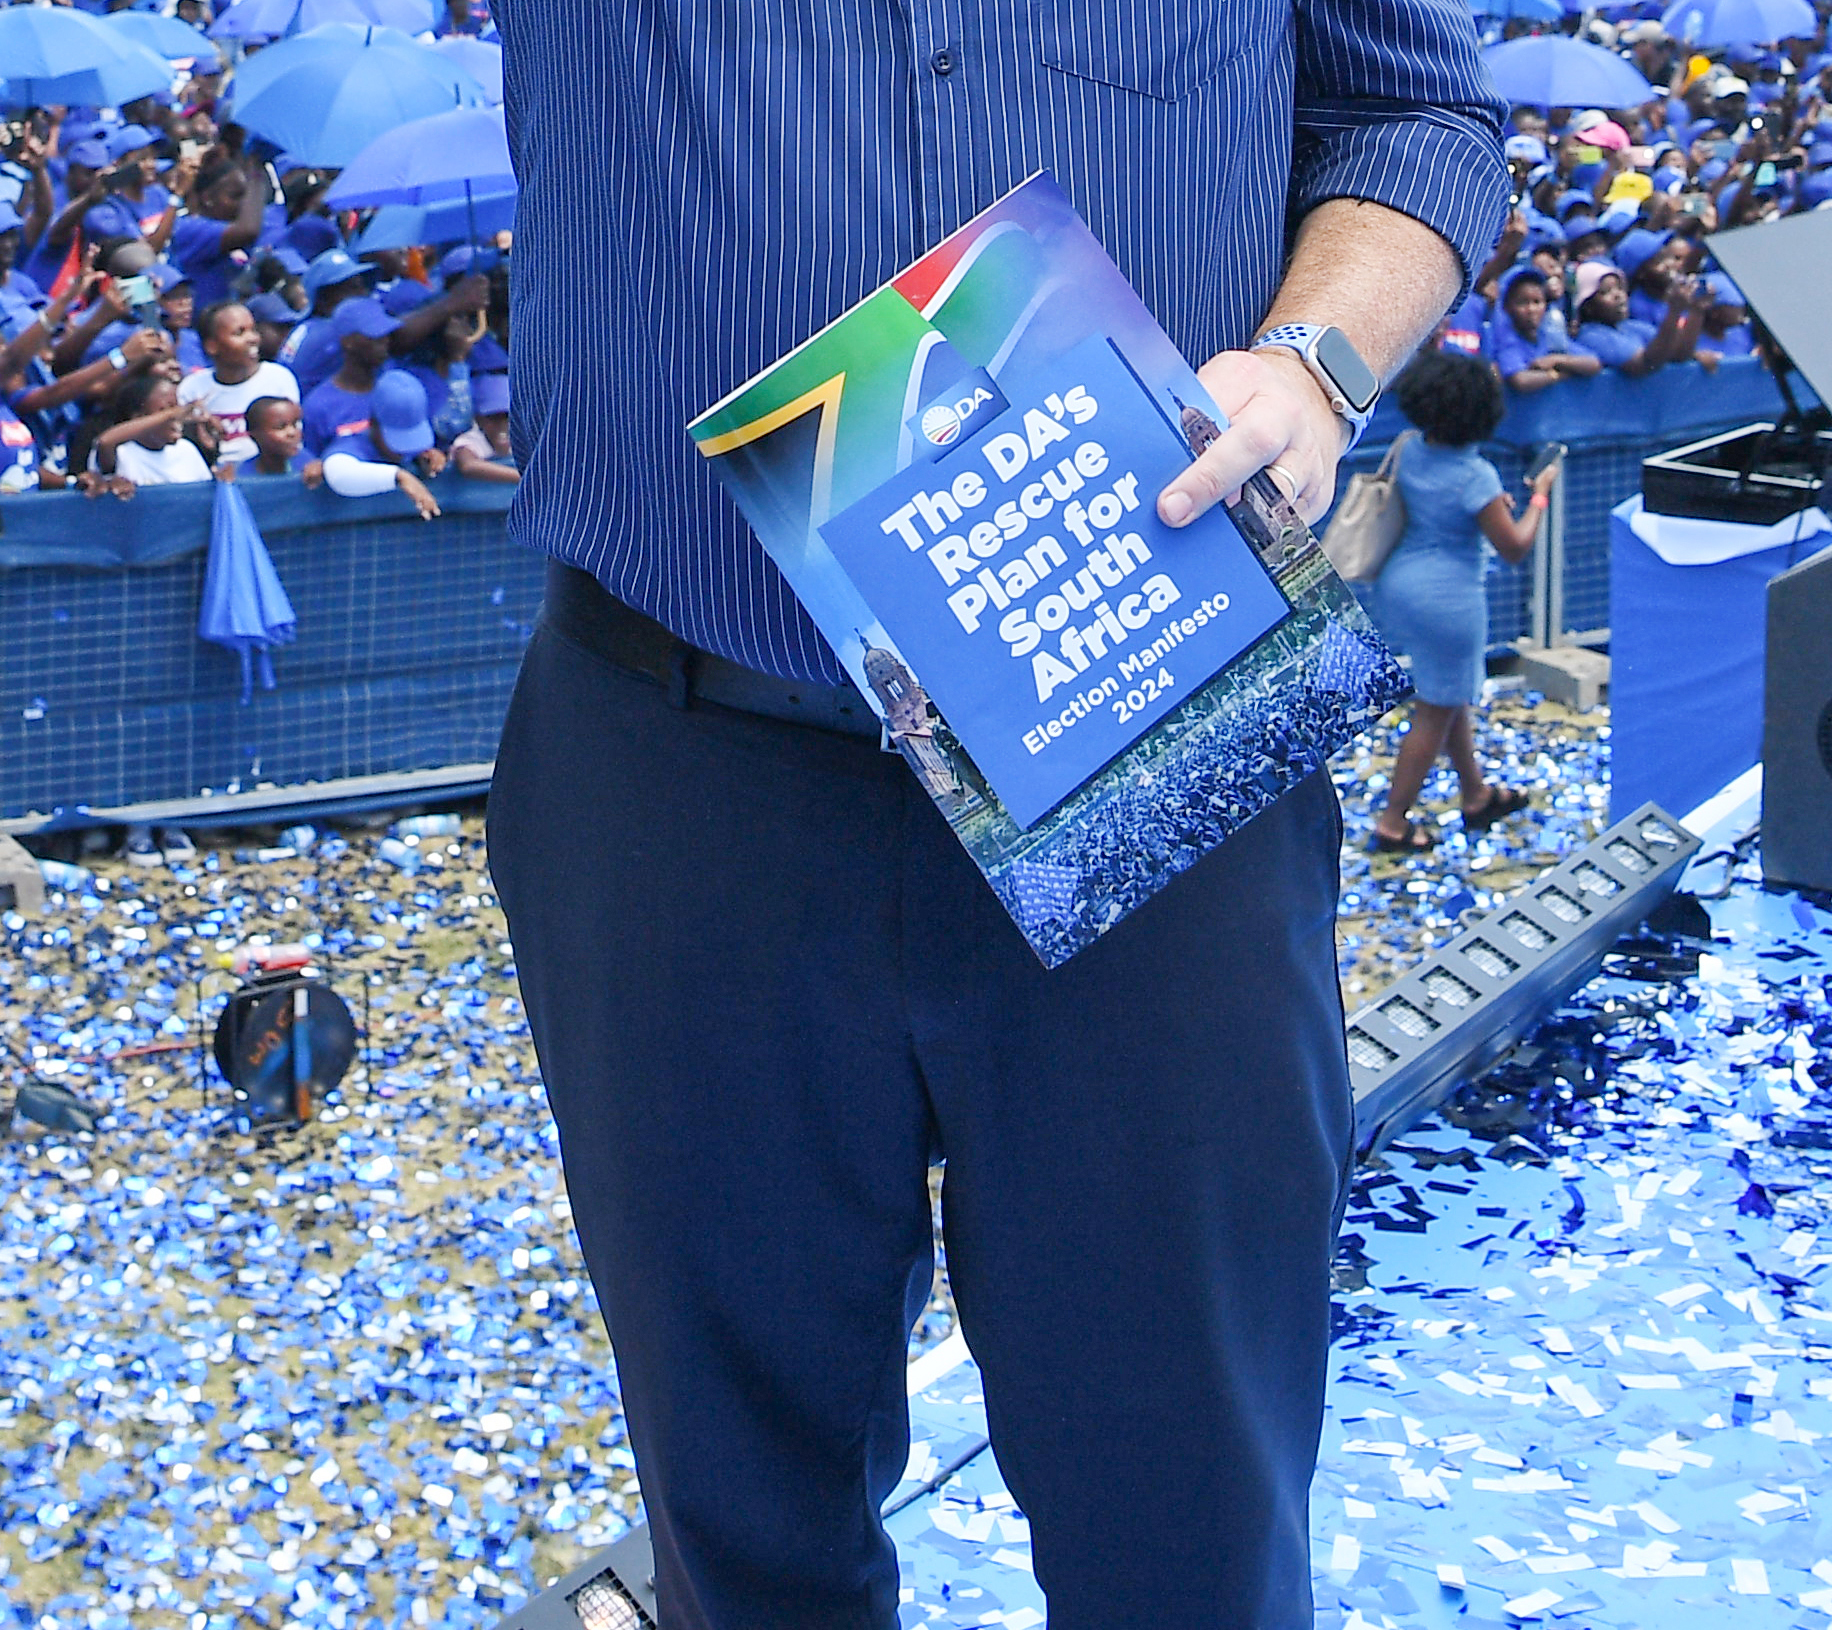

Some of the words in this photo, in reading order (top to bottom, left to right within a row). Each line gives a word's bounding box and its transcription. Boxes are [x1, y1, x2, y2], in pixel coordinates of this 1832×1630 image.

[879, 471, 988, 552] The
[981, 384, 1099, 484] DA's
[953, 386, 994, 421] DA
[926, 441, 1110, 587] Rescue
[946, 535, 1068, 635] Plan
[1063, 471, 1140, 548] for
[998, 532, 1153, 658] South
[1031, 573, 1182, 704] Africa
[1021, 676, 1120, 756] Election
[1117, 593, 1230, 682] Manifesto
[1111, 667, 1175, 724] 2024
